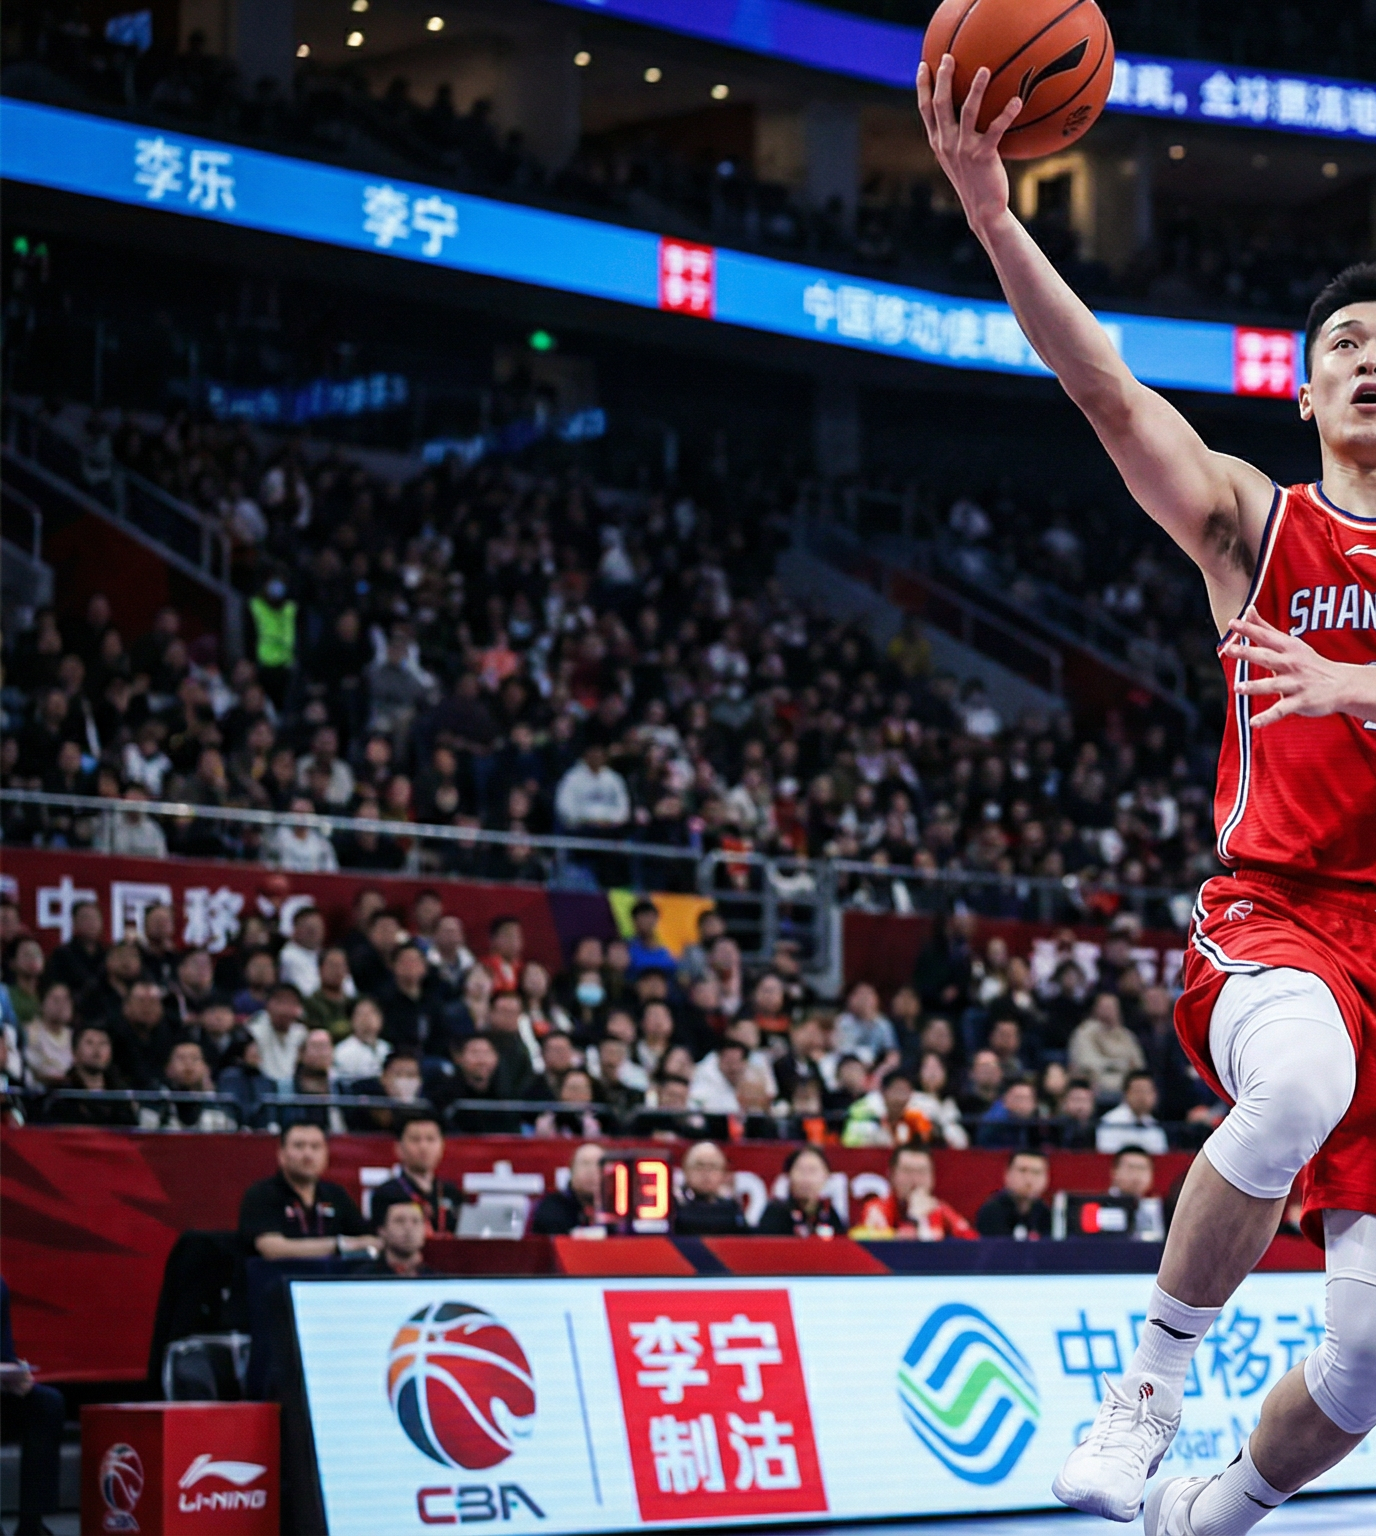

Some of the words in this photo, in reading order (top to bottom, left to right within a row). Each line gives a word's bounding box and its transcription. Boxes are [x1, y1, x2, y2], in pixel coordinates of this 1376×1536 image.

[613, 1160, 669, 1220] 13
[628, 1315, 783, 1404] 李宁
[417, 1485, 546, 1525] CBA
